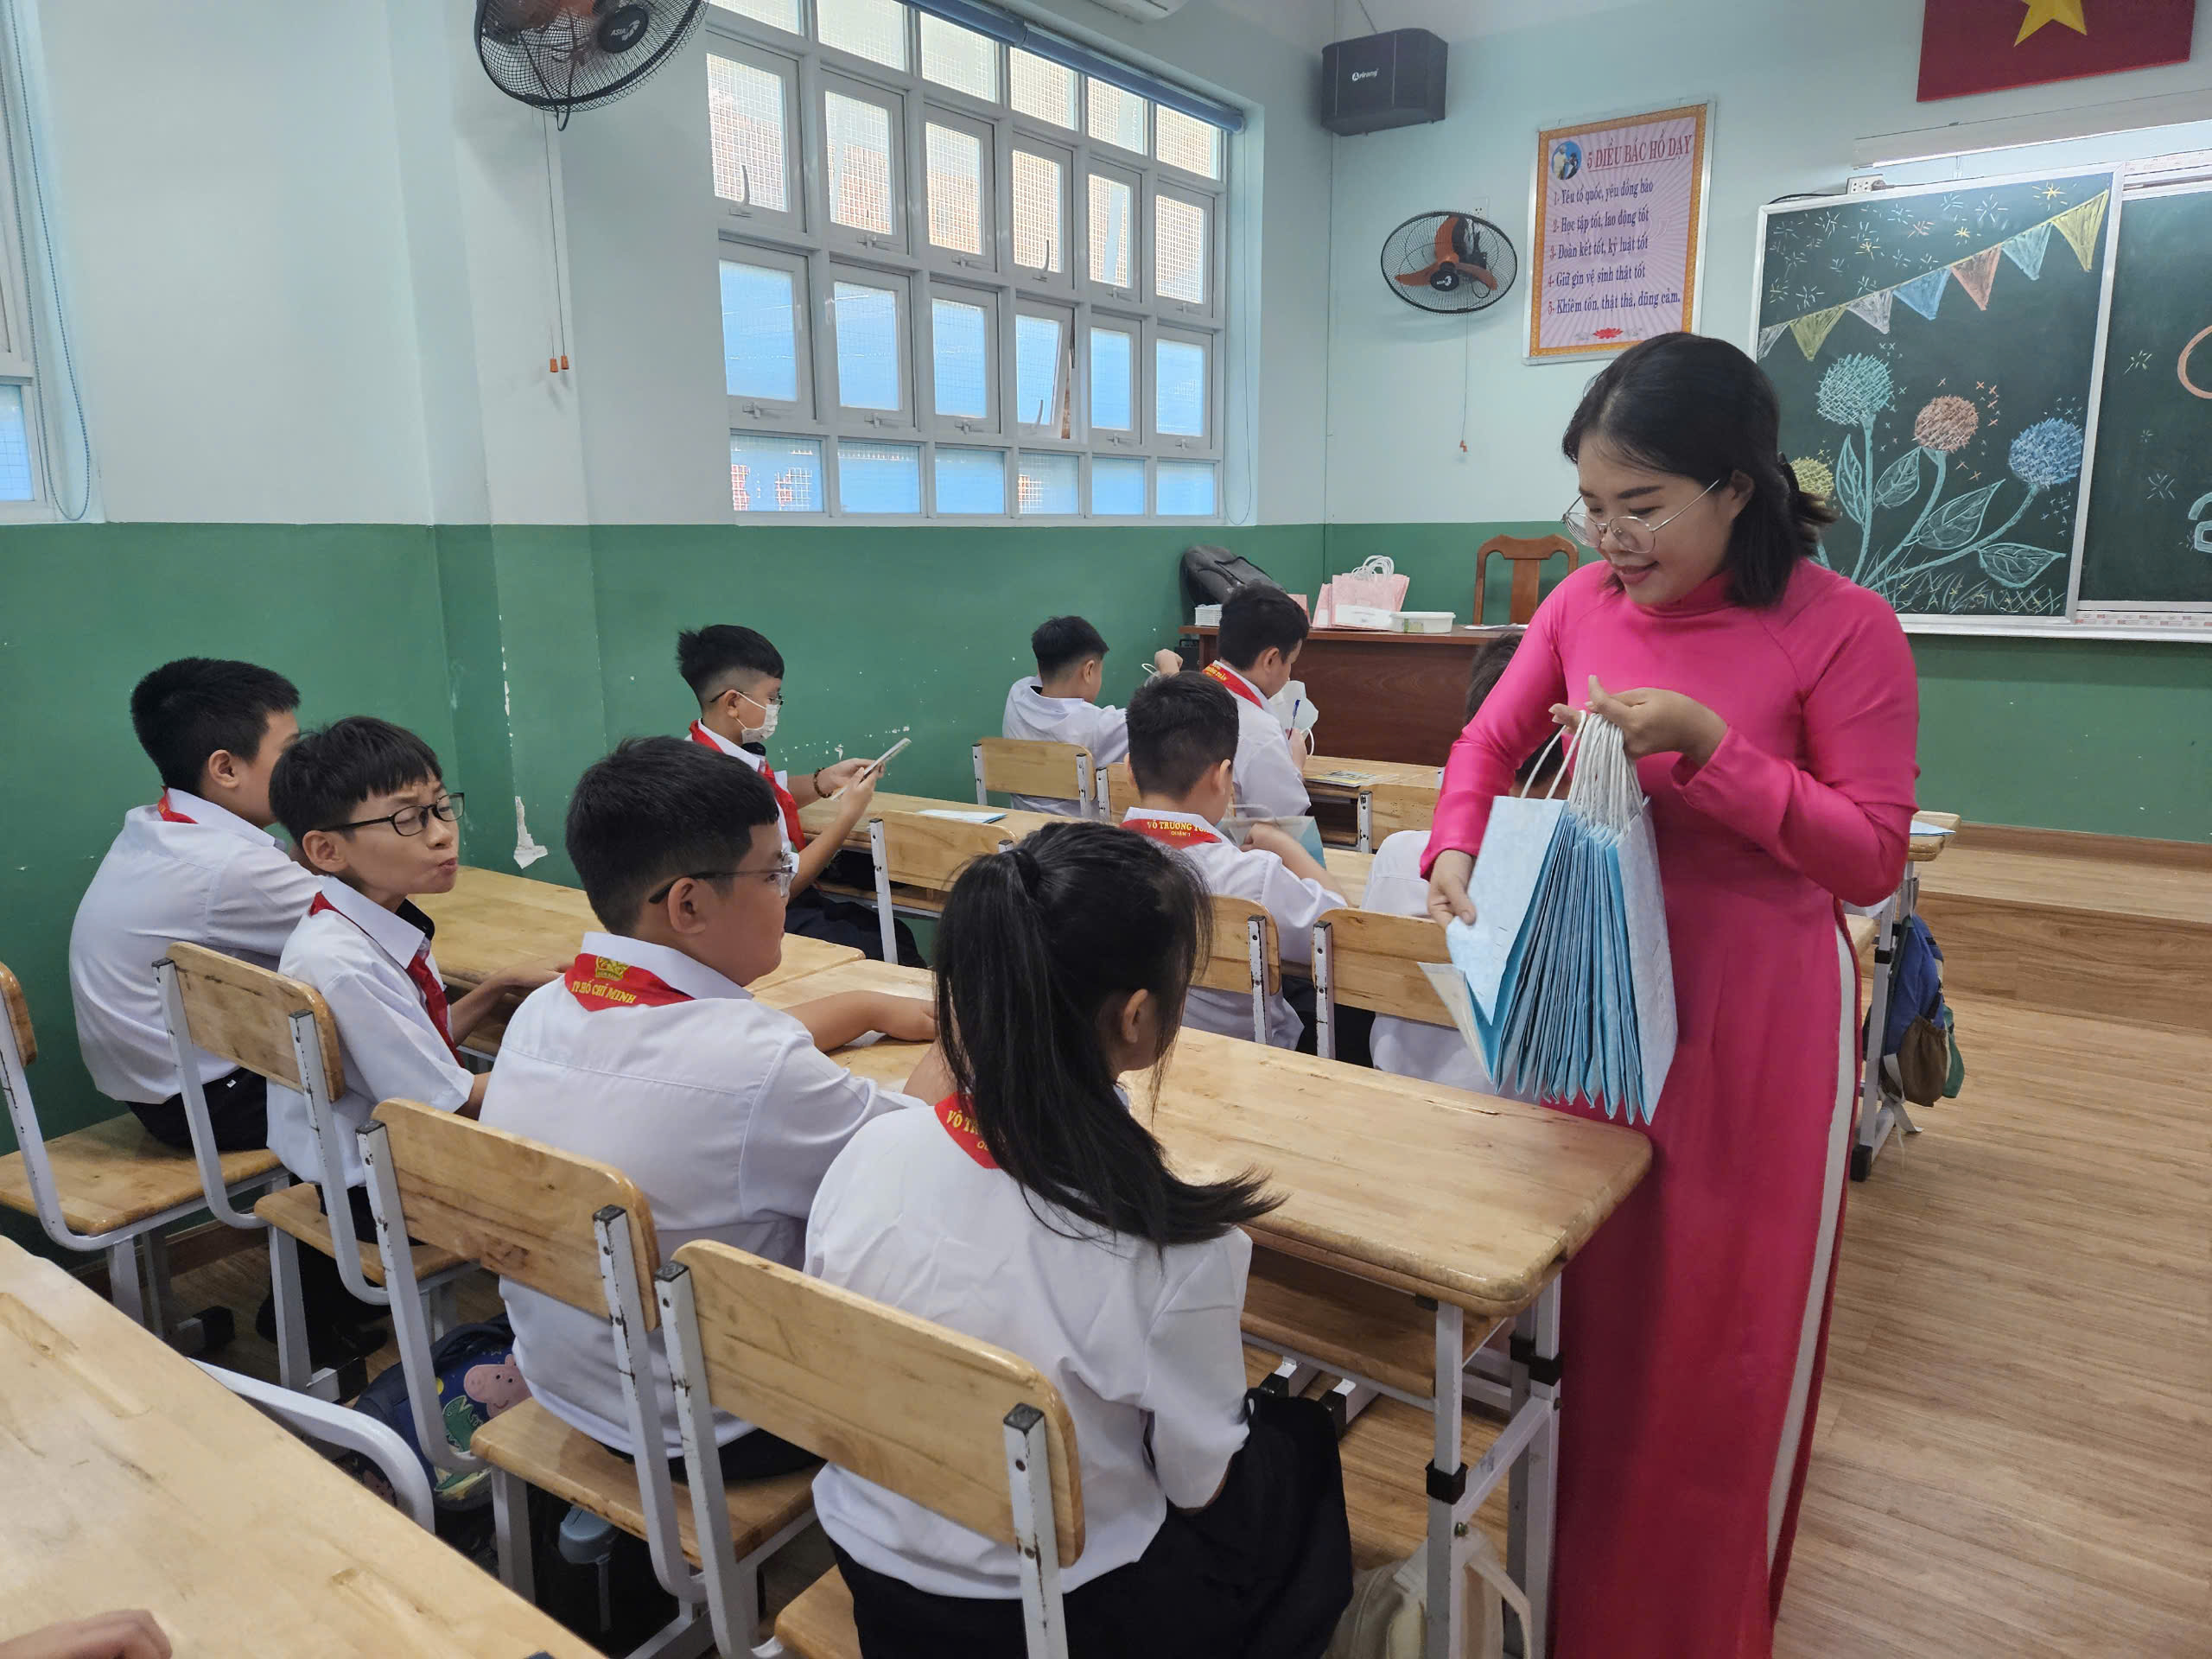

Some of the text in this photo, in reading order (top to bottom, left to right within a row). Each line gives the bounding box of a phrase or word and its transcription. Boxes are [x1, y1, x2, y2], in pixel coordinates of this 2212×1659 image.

[1587, 129, 1692, 168] 5 ĐIỀU BÁC HỒ DẠY
[1561, 217, 1574, 234] Học
[1605, 212, 1616, 226] lao
[1638, 204, 1649, 222] tốt
[1580, 238, 1592, 257] kết
[1638, 232, 1648, 250] tốt
[1598, 266, 1613, 282] sinh
[1635, 261, 1645, 278] tốt
[1557, 298, 1582, 314] Khiêm
[592, 983, 608, 997] CHÍ
[607, 988, 637, 1003] MINH
